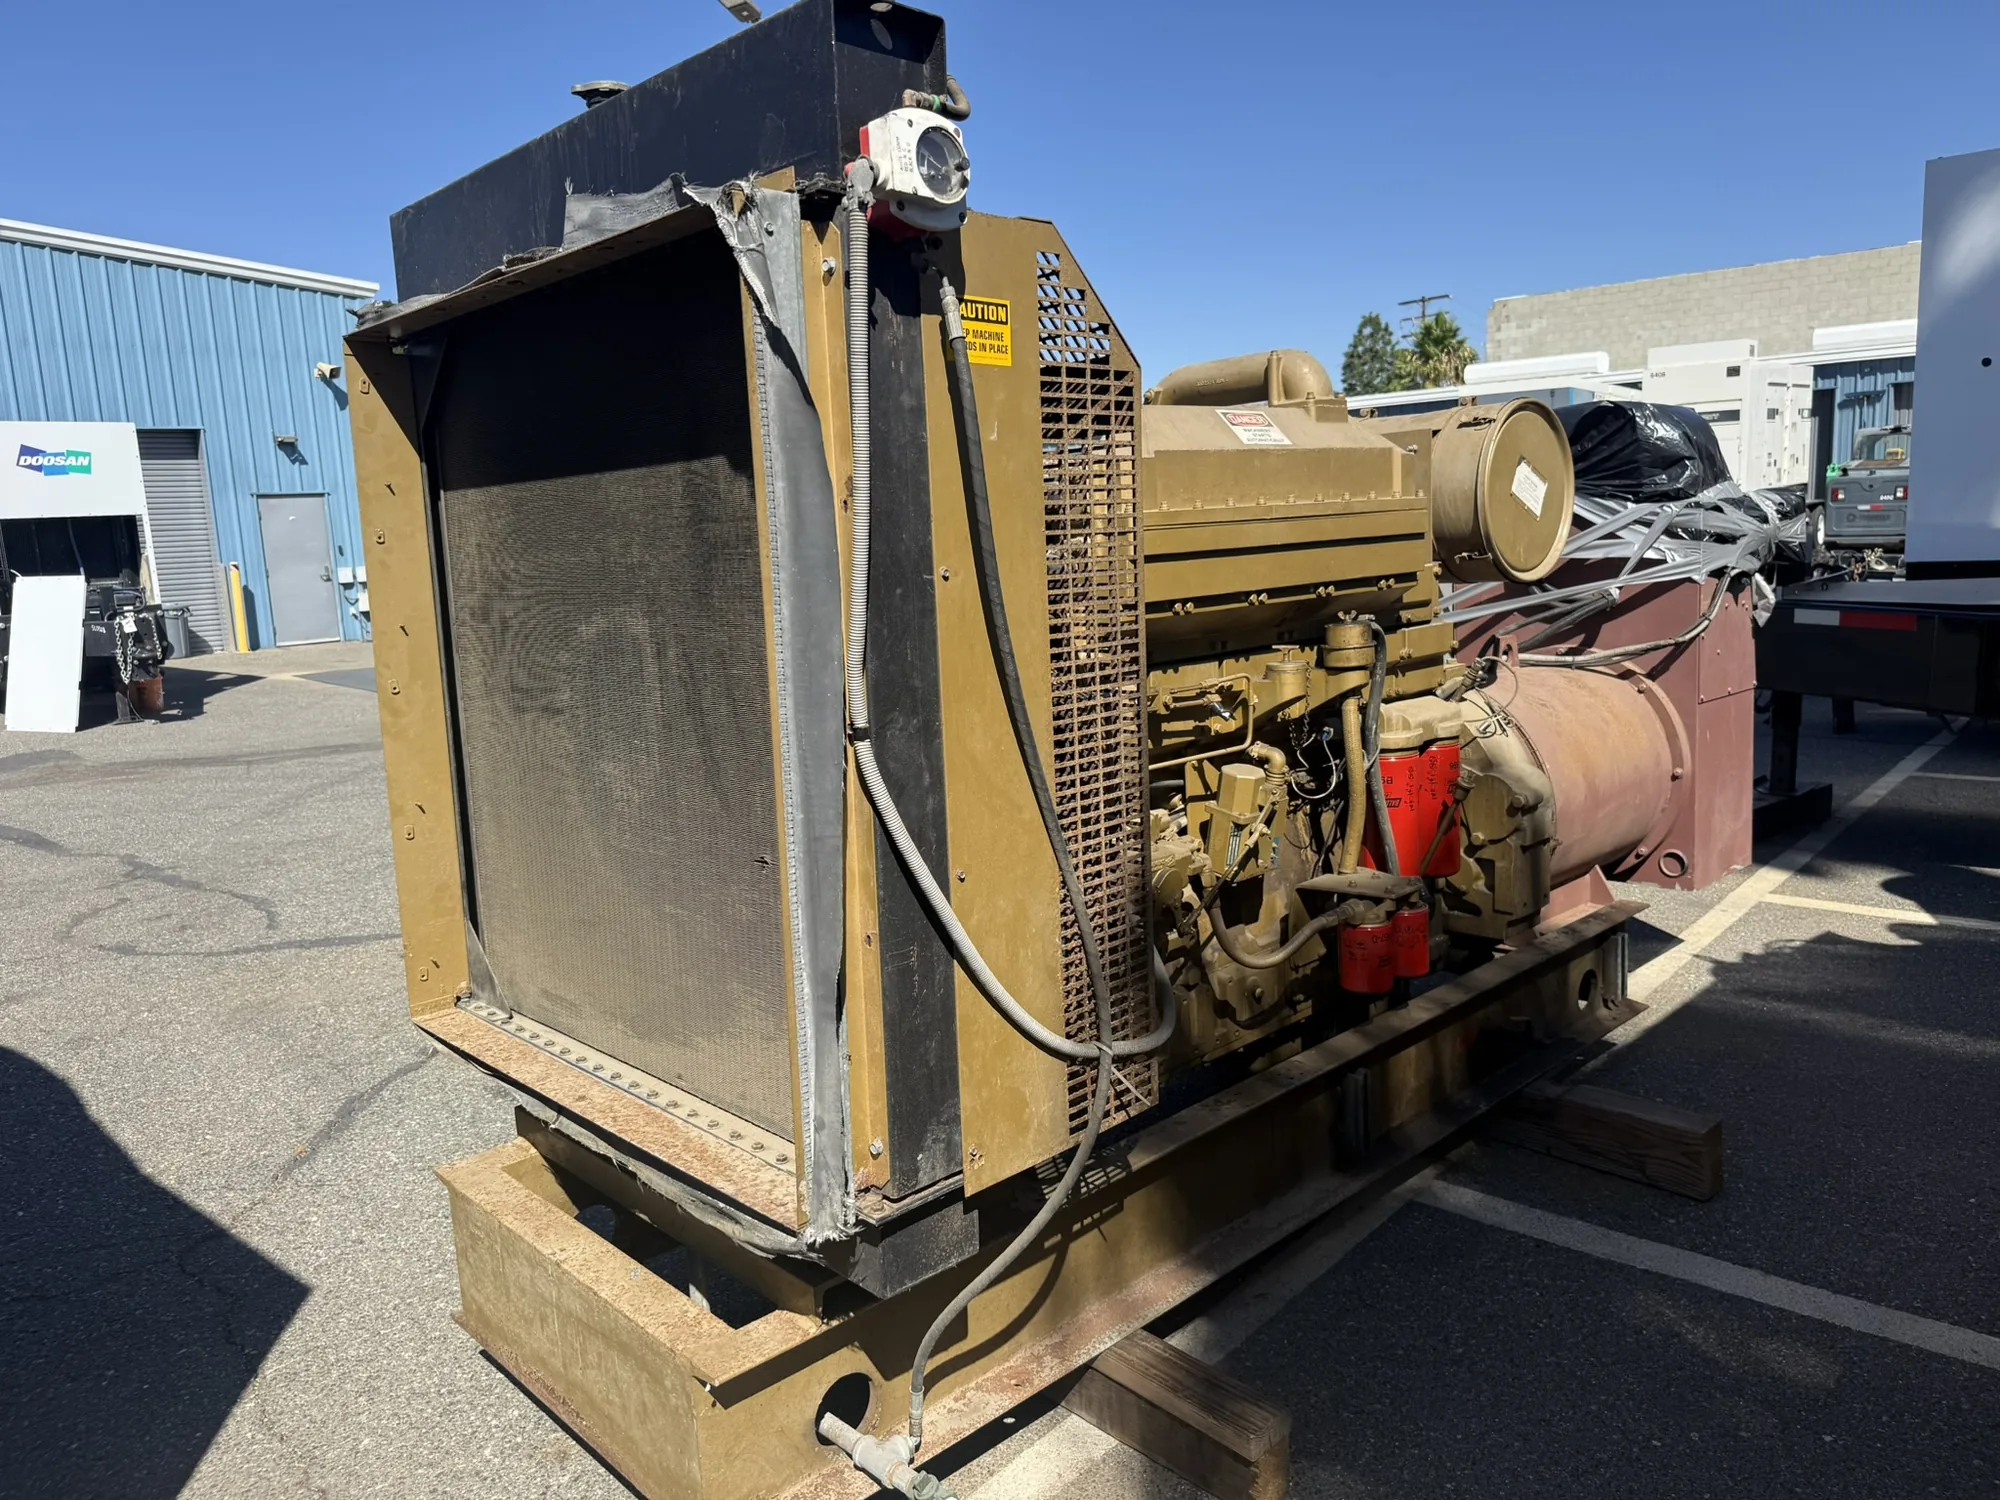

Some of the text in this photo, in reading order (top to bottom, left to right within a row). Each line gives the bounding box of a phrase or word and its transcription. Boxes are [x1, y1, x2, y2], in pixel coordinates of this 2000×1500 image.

[960, 302, 1007, 322] AUTION
[972, 328, 1005, 342] MACHINE
[979, 342, 987, 352] IN
[988, 343, 1009, 354] PLACE
[1228, 415, 1266, 425] DANGER
[18, 455, 90, 466] DOOSAN
